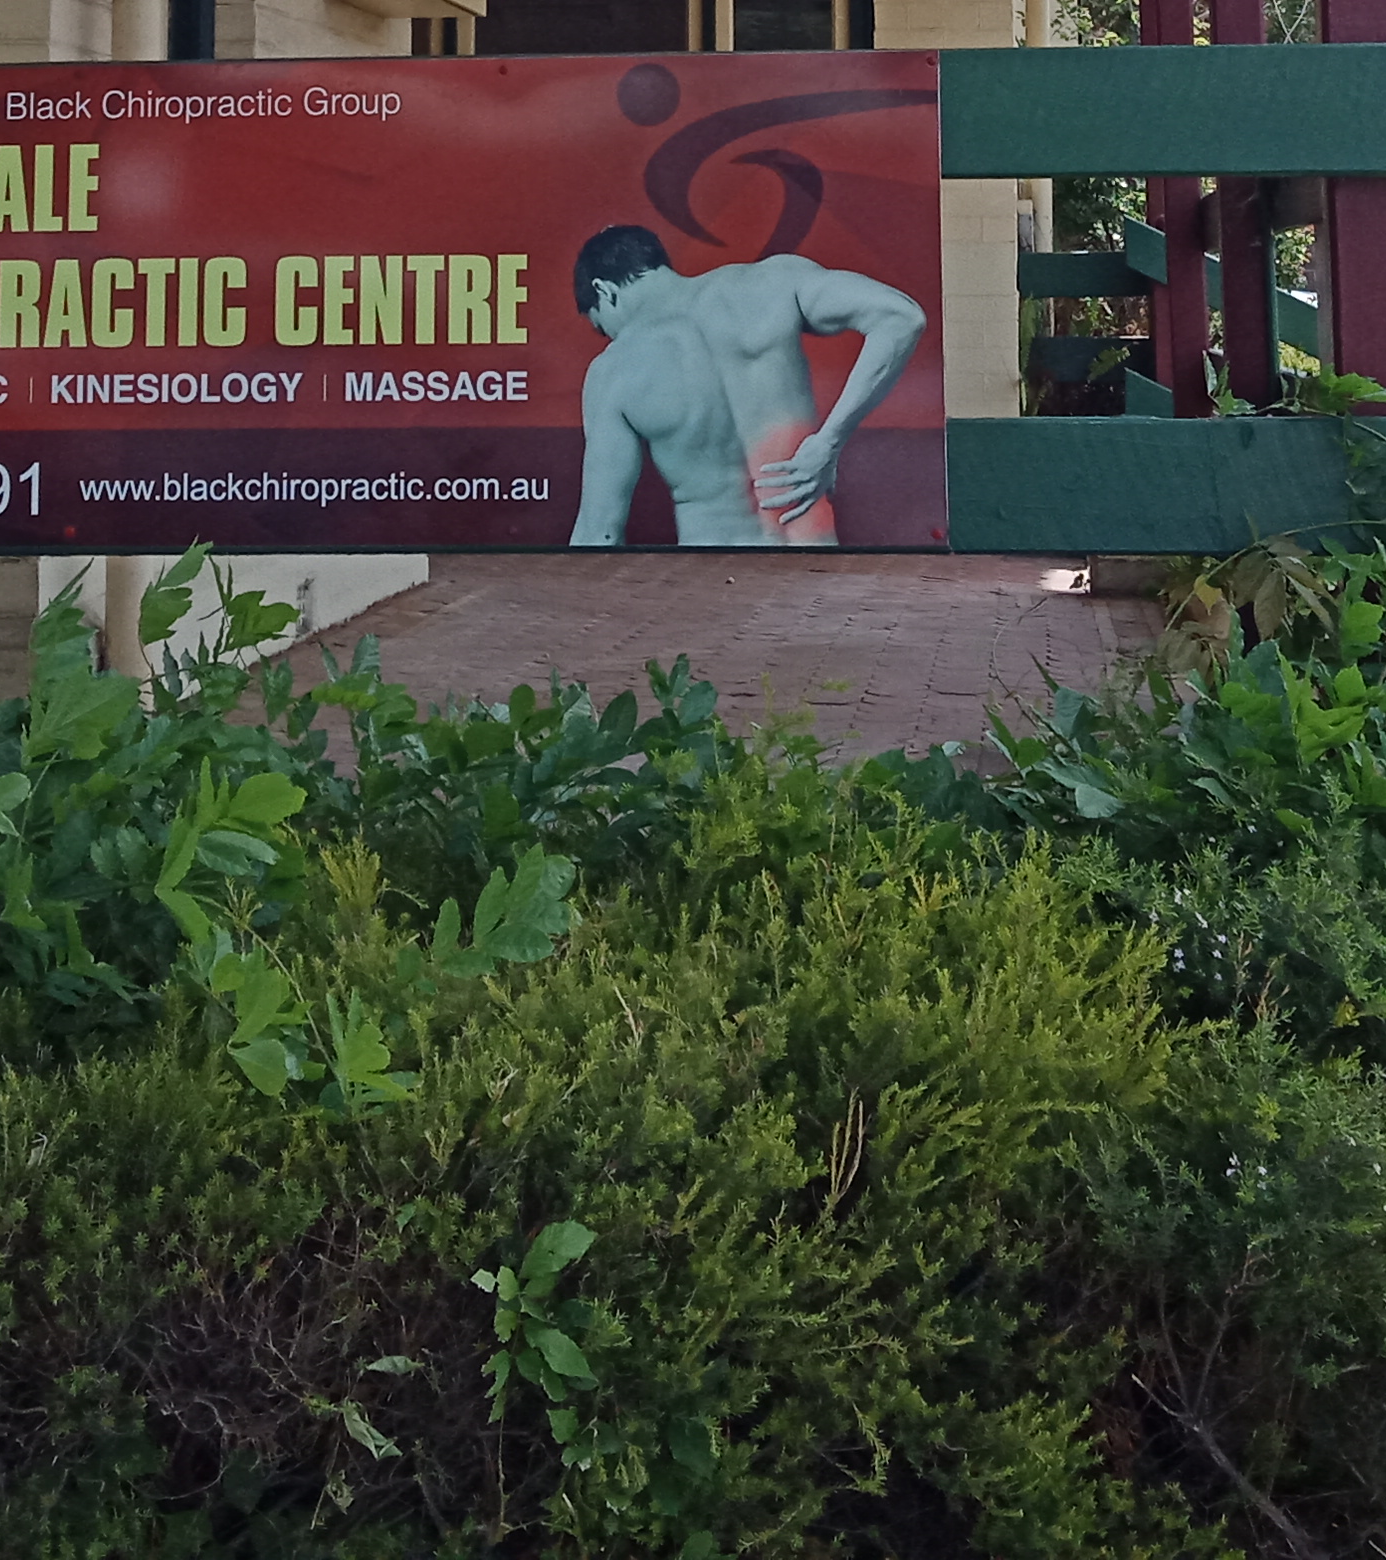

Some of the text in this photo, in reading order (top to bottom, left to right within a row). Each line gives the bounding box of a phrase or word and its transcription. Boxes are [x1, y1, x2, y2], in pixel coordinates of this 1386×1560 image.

[6, 91, 91, 121] Black
[101, 88, 293, 124] Chiropractic
[303, 86, 402, 122] Group
[274, 253, 529, 347] CENTRE
[50, 372, 304, 404] KINESIOLOGY
[344, 370, 530, 402] MASSAGE
[79, 471, 550, 508] www.blackchiropractic.com.au
